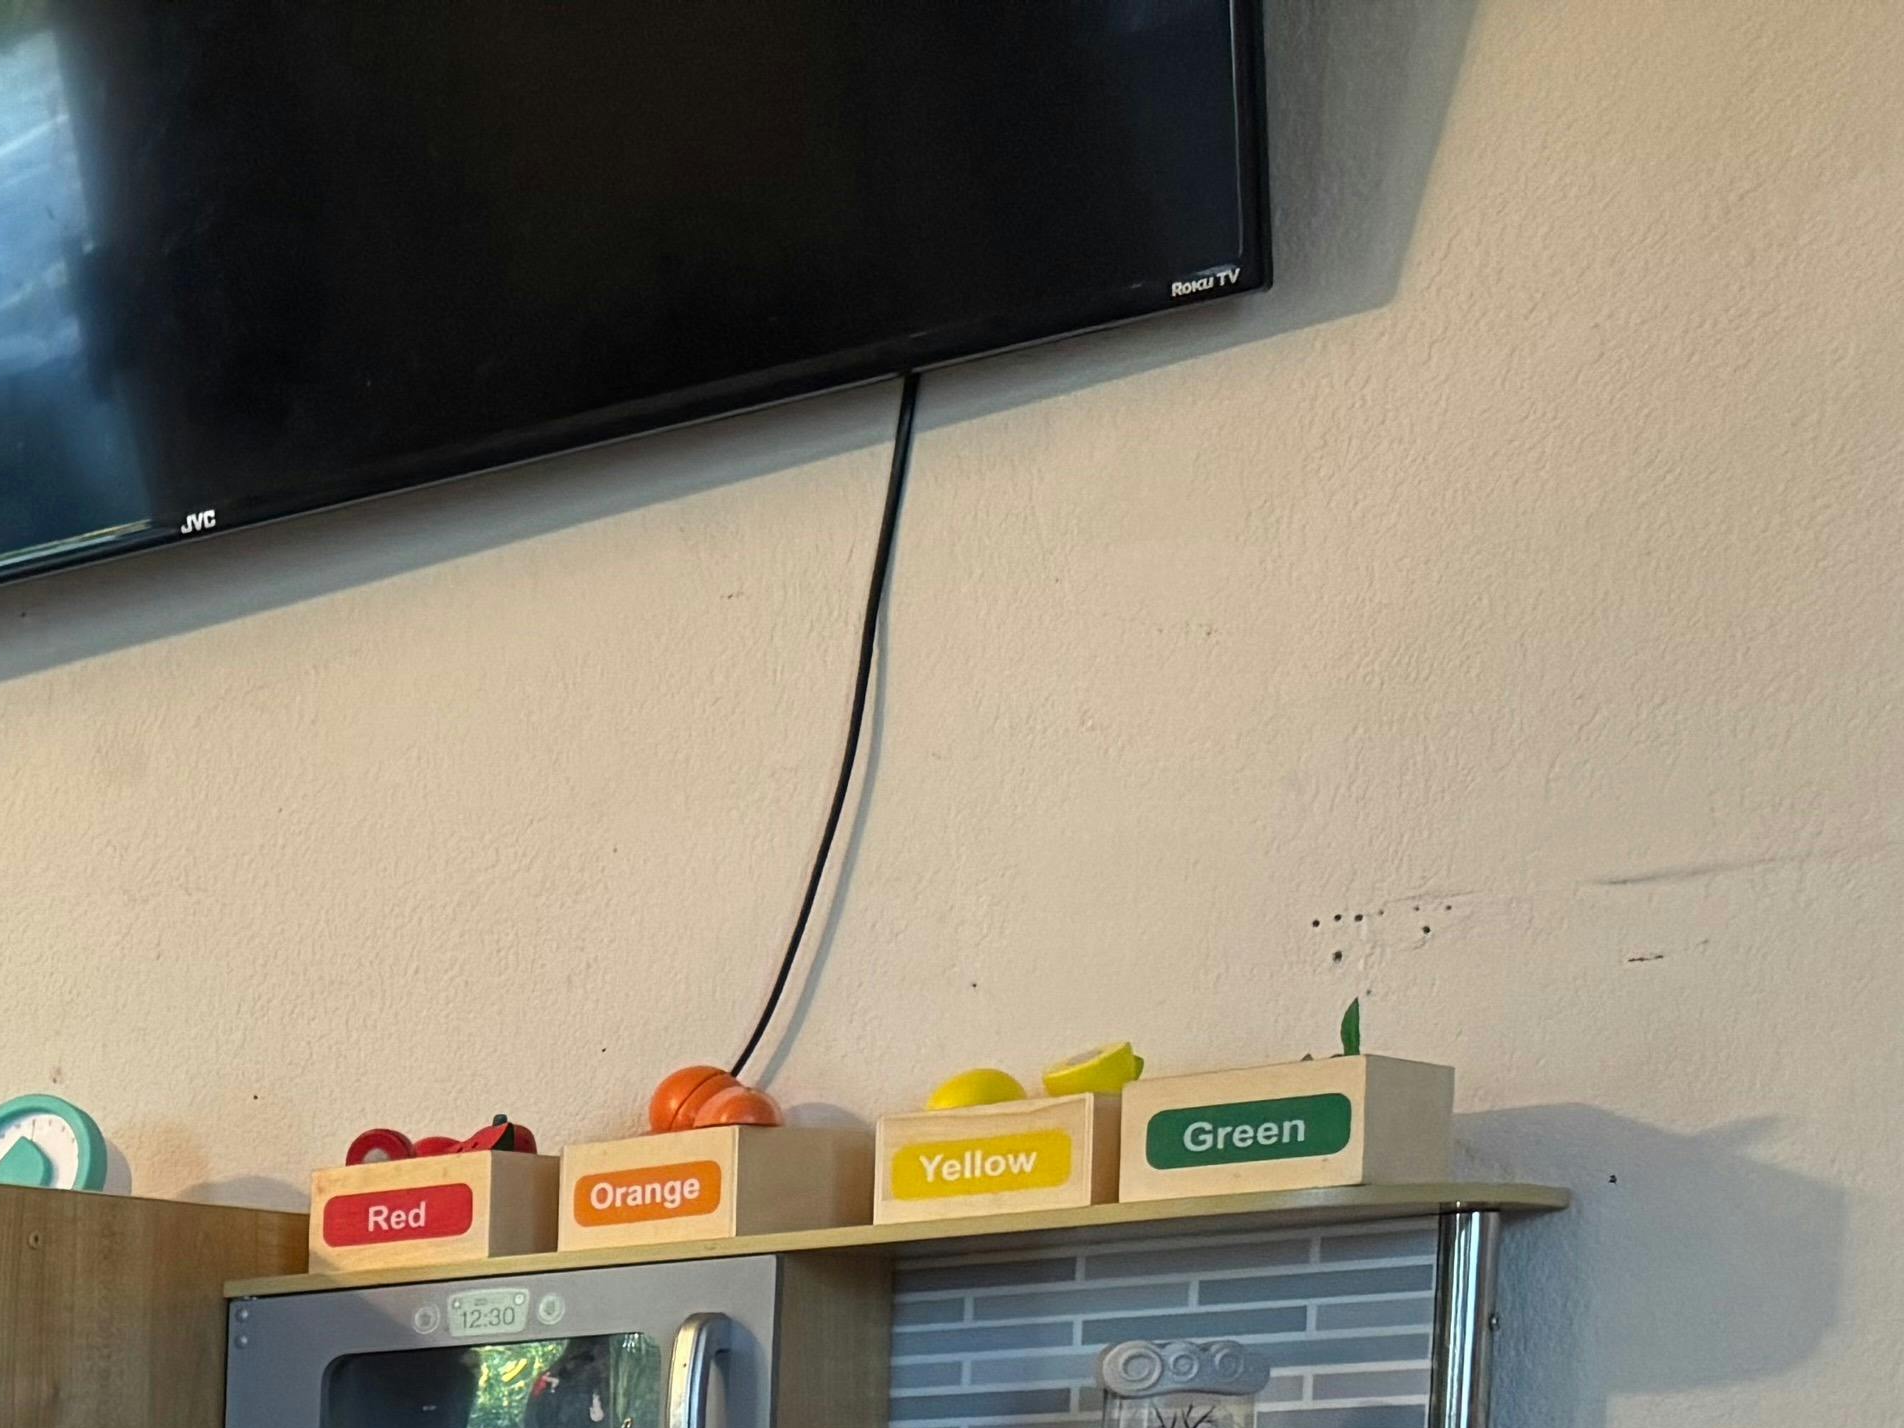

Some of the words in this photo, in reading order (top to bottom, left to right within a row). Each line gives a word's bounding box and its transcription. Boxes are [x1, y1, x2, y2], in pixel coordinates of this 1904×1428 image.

[1171, 277, 1214, 297] Roku
[1216, 267, 1241, 286] TV
[180, 509, 216, 534] JVC
[1182, 1114, 1306, 1153] Green
[918, 1149, 1039, 1184] Yellow
[589, 1174, 702, 1212] Orange
[366, 1201, 428, 1233] Red
[460, 1306, 517, 1330] 12:30
